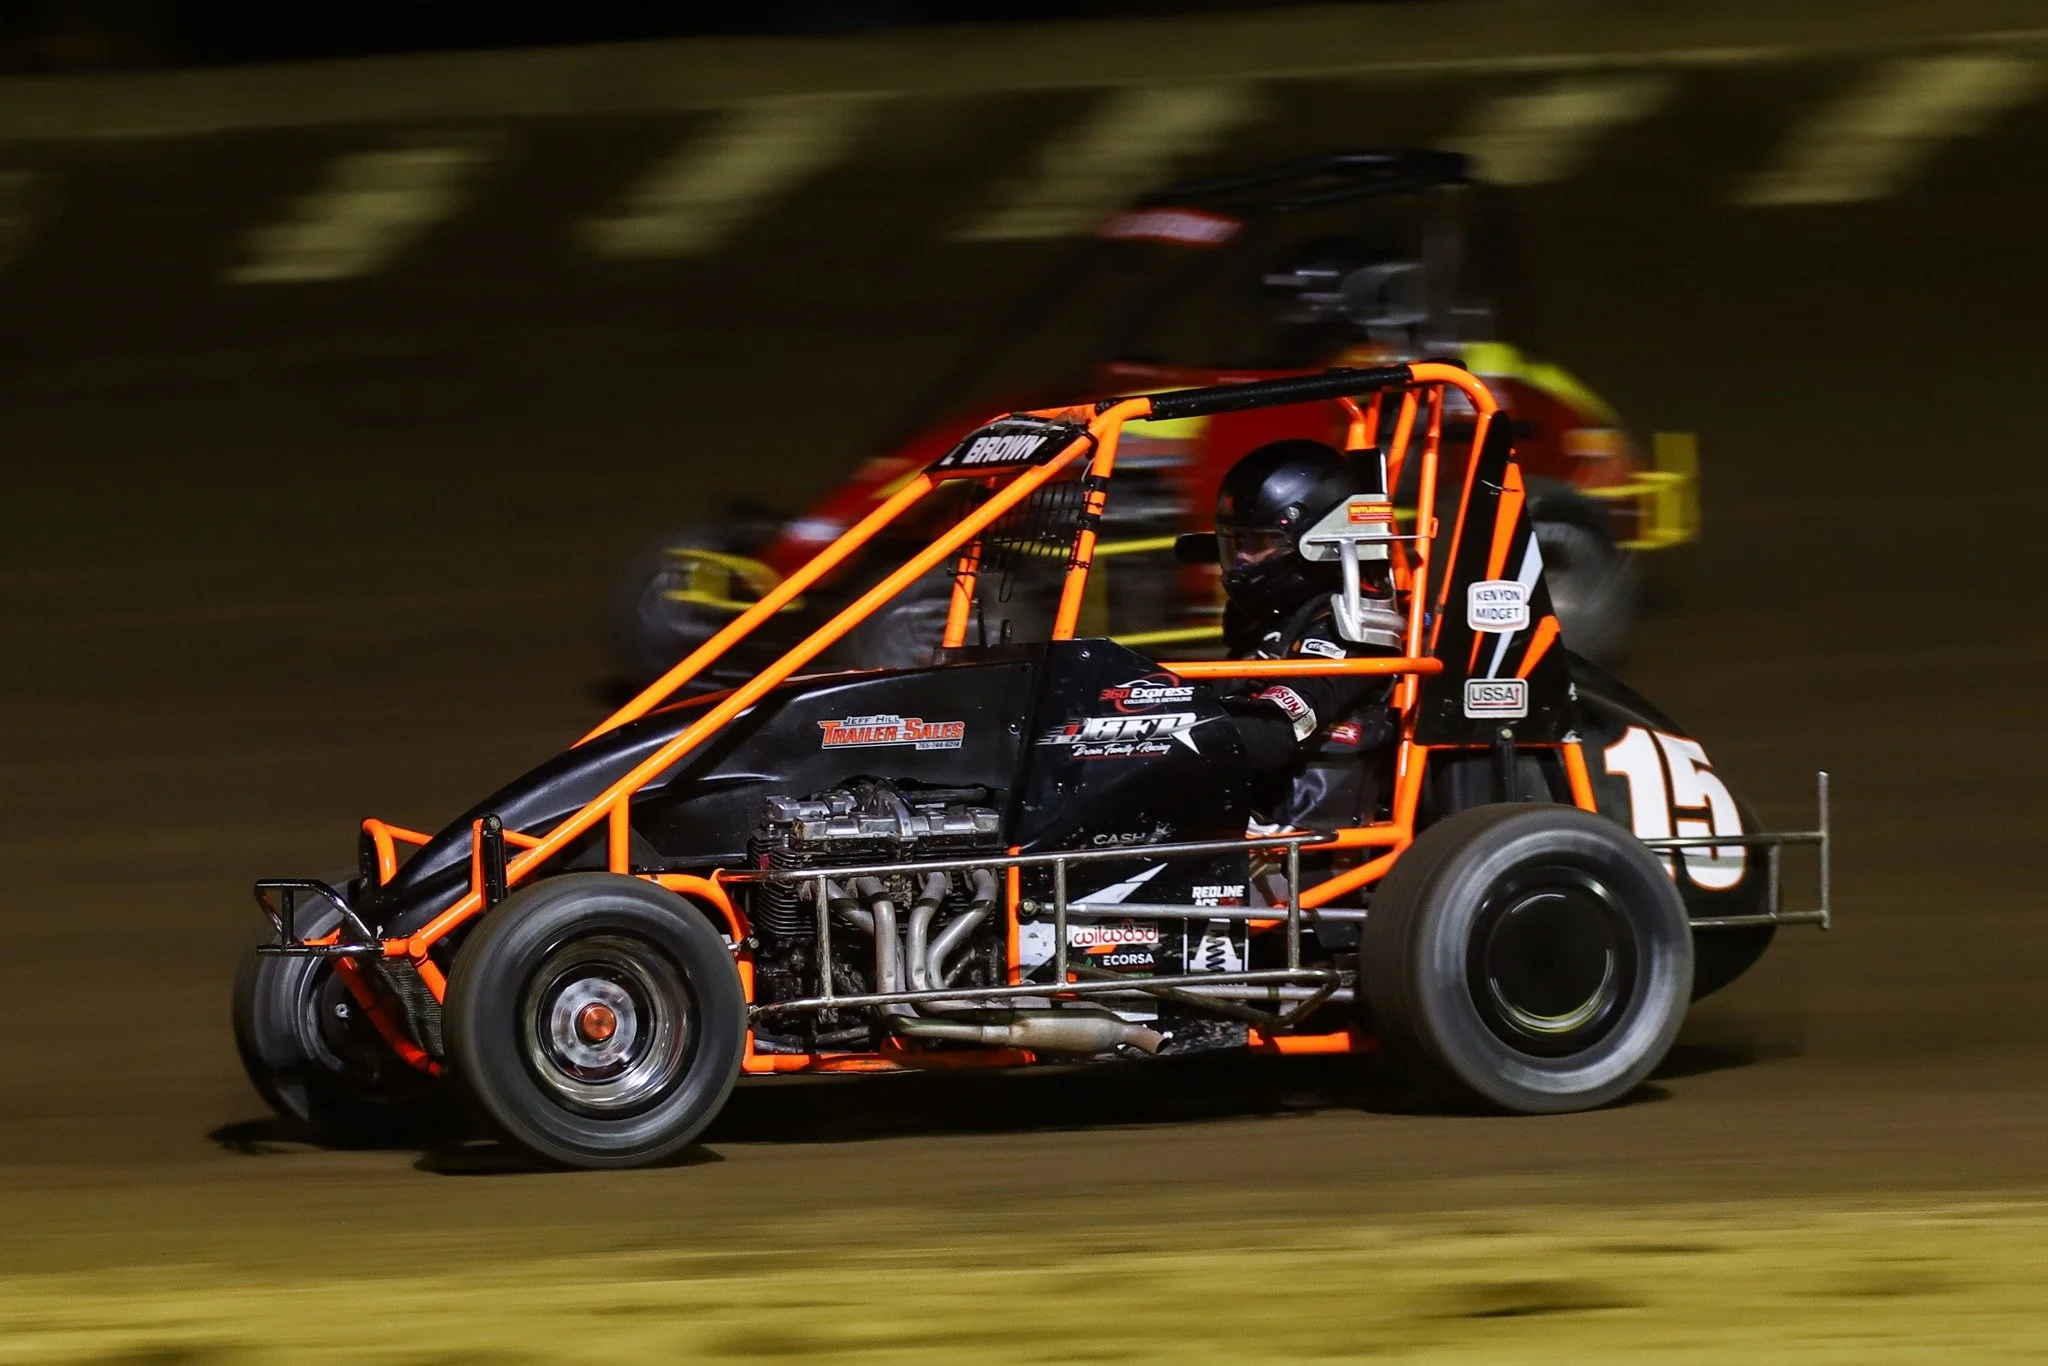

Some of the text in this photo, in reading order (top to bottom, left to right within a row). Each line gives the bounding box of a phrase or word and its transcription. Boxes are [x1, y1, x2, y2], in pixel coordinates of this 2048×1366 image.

[961, 435, 1048, 464] BROWN
[1475, 589, 1521, 601] KENYON
[1475, 607, 1520, 620] MIDGET
[843, 715, 900, 726] JEFF HILL
[818, 718, 965, 745] TRAILER SALES
[1604, 725, 1748, 892] 15
[1191, 885, 1245, 899] REDLINE
[1073, 926, 1158, 945] wilwood
[1102, 952, 1155, 967] ECORSA
